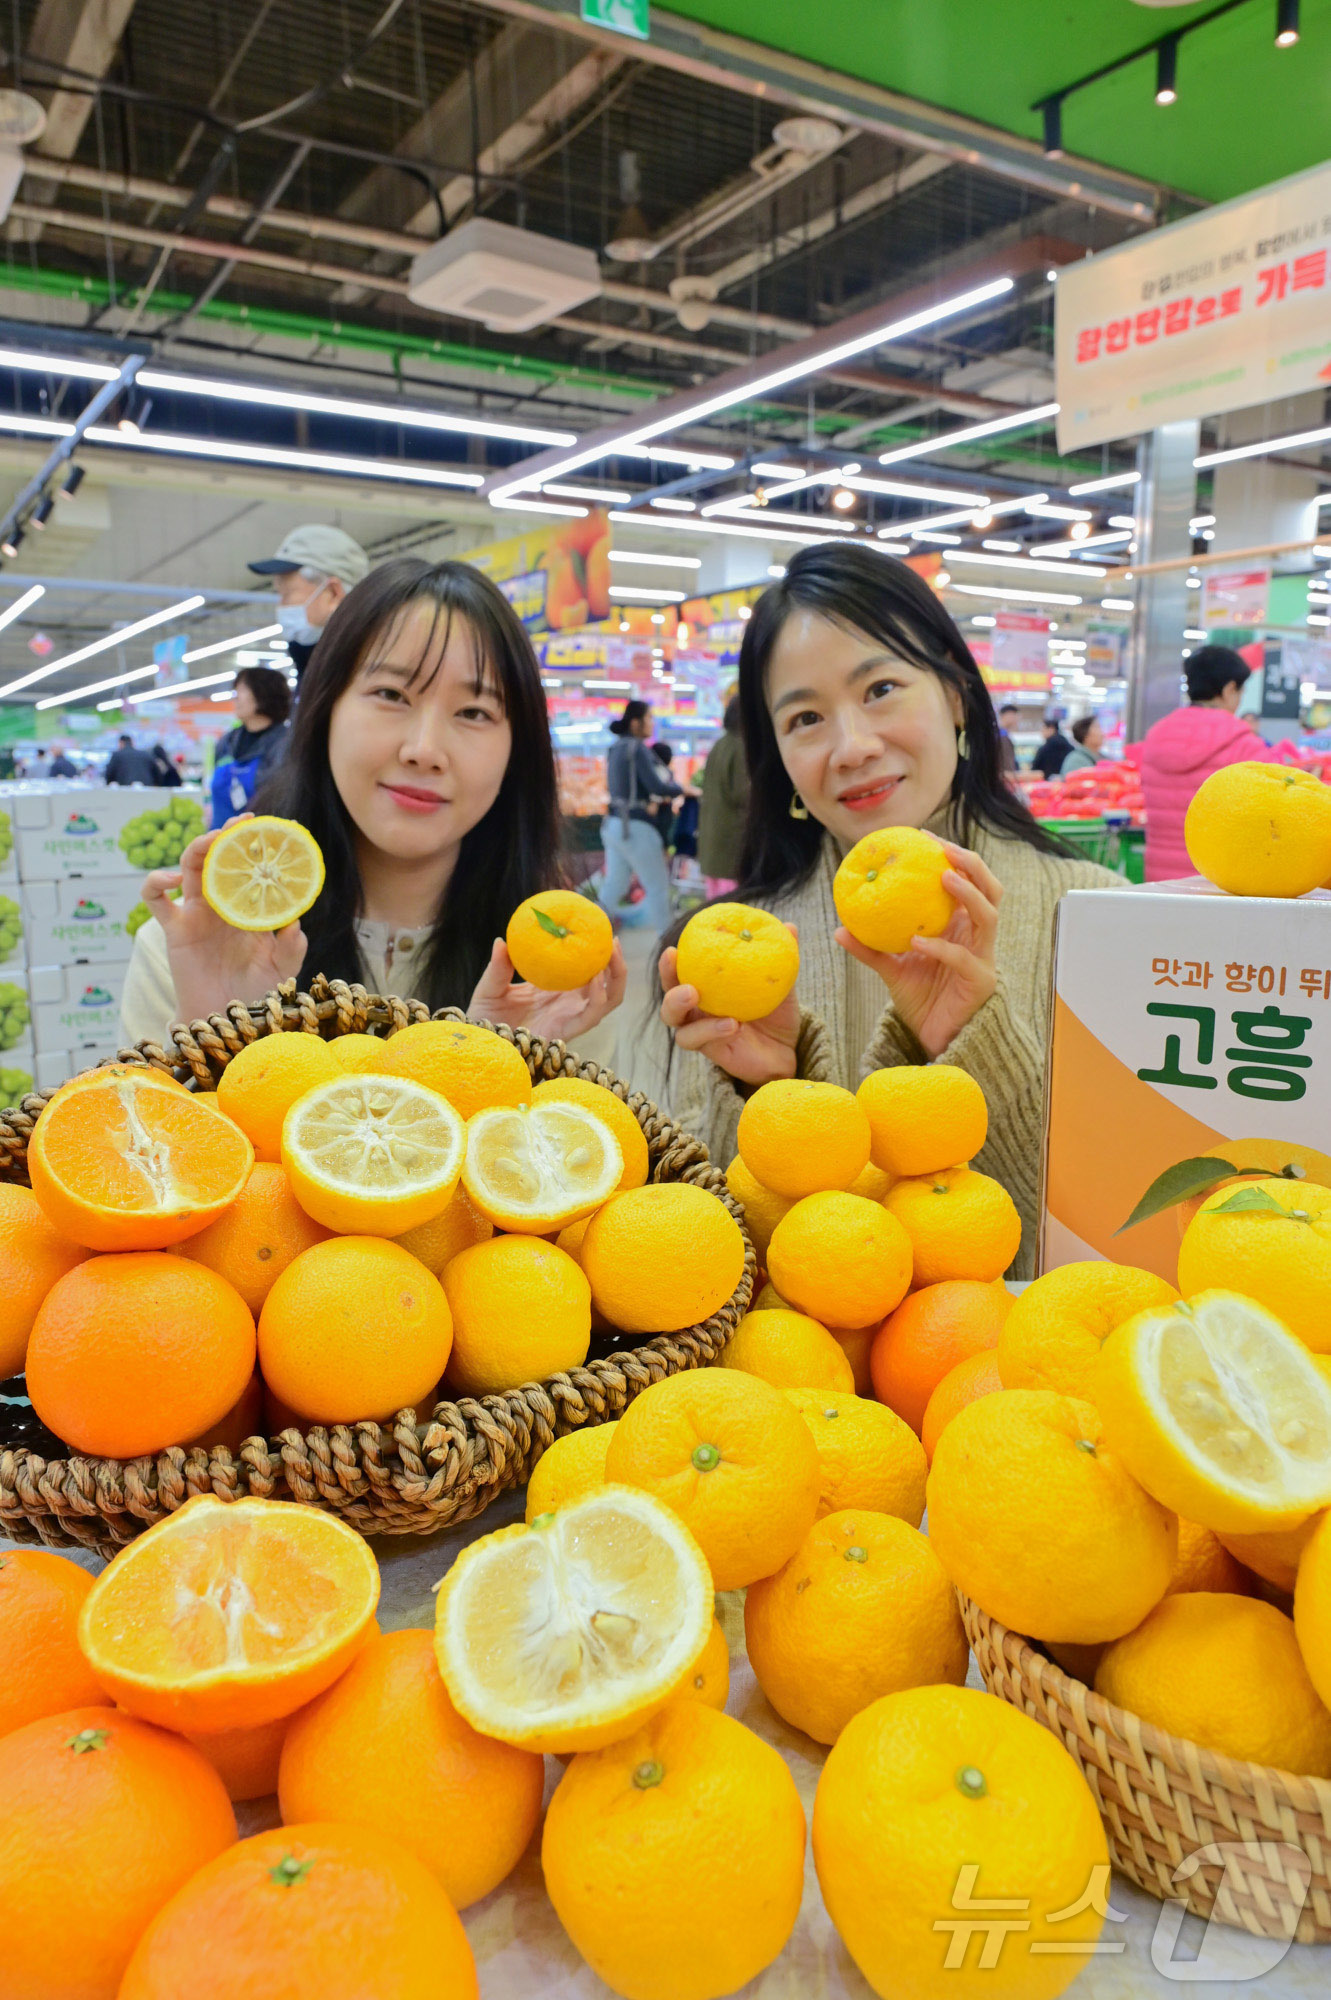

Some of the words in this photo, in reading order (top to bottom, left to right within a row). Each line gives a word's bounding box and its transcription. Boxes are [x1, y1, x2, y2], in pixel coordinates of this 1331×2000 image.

[1255, 248, 1327, 307] 가득
[1152, 957, 1214, 989] 맛과
[1225, 962, 1287, 996] 향이
[1299, 968, 1331, 1000] 뛰
[1137, 1002, 1313, 1102] 고흥
